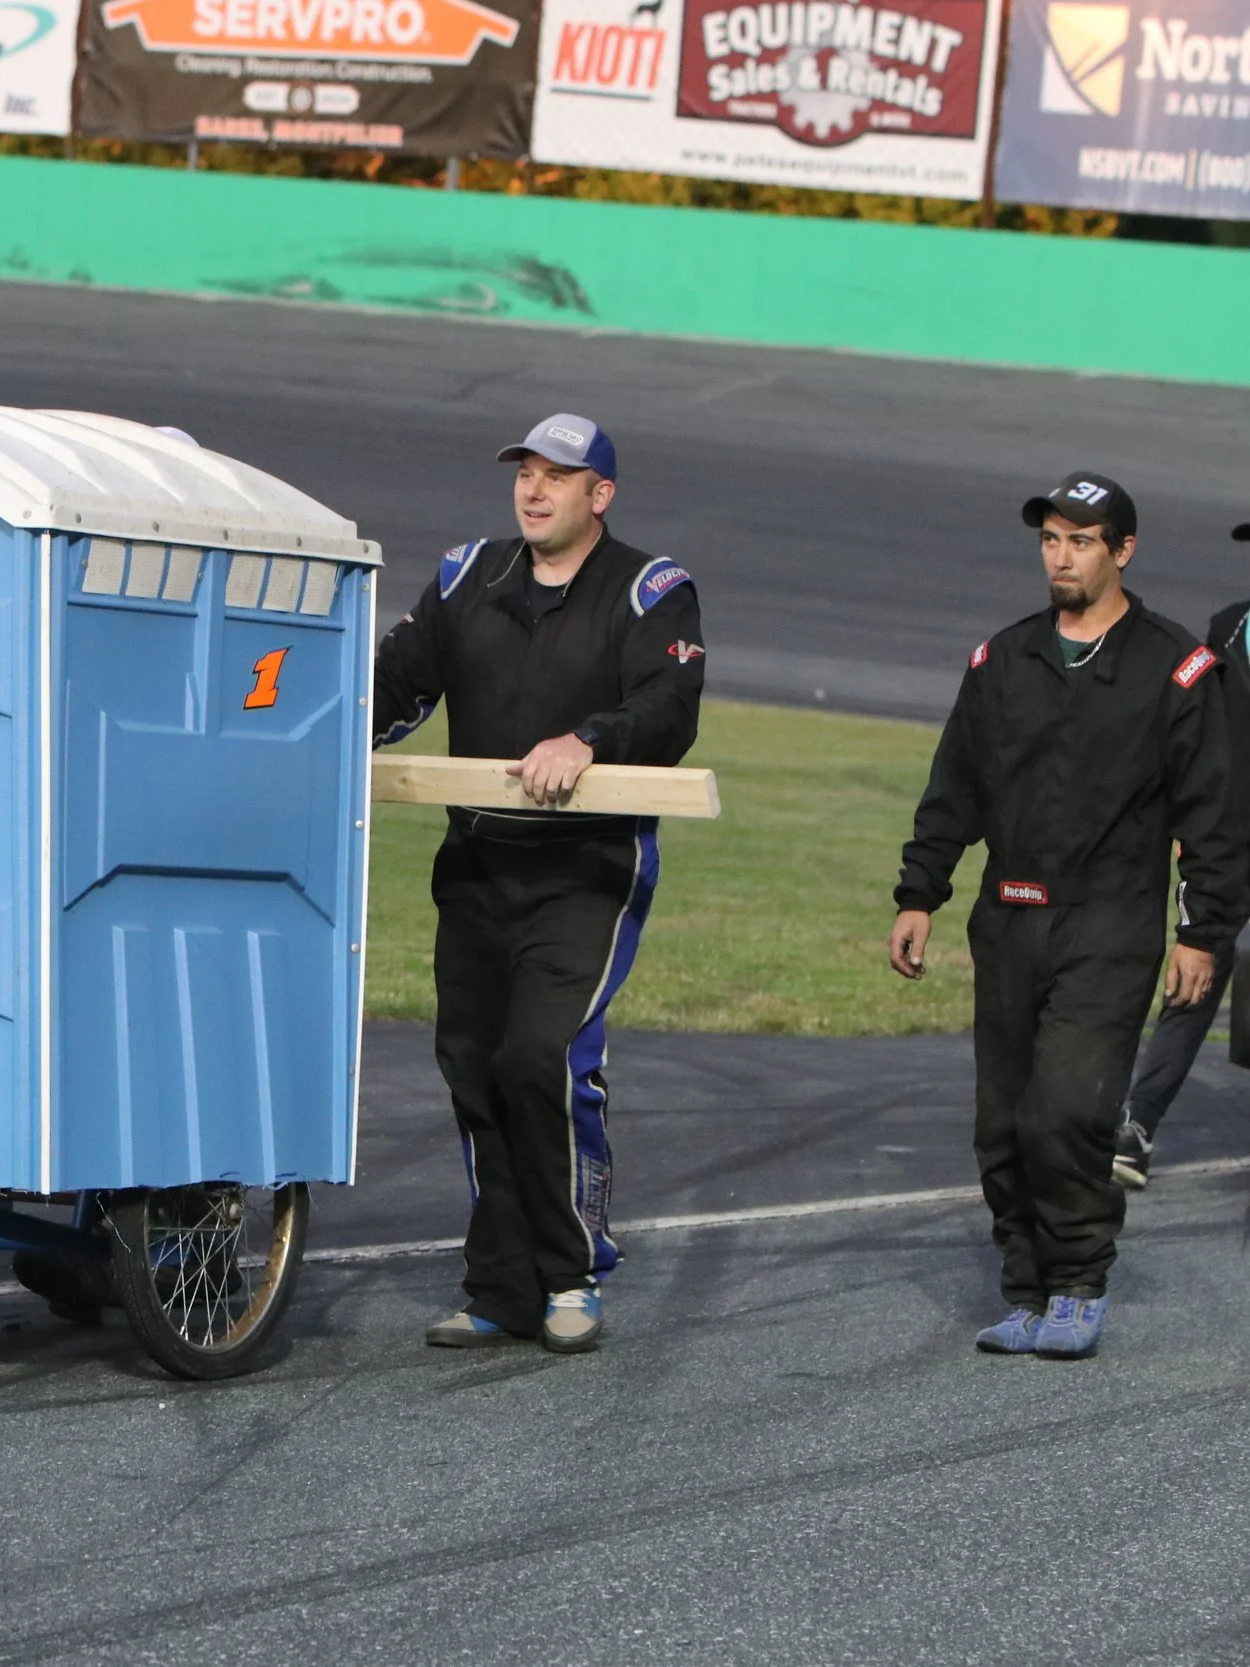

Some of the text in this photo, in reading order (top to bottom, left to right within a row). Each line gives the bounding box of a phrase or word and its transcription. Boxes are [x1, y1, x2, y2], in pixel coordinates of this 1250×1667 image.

[193, 0, 424, 44] SERVPRO
[702, 2, 963, 73] EQUIPMENT
[554, 22, 666, 89] KIOTI
[707, 57, 793, 102] Sales
[798, 55, 822, 90] &
[827, 54, 943, 117] Rentals
[1067, 481, 1109, 506] 31
[243, 645, 294, 711] 1
[1004, 885, 1043, 901] RaceQuip
